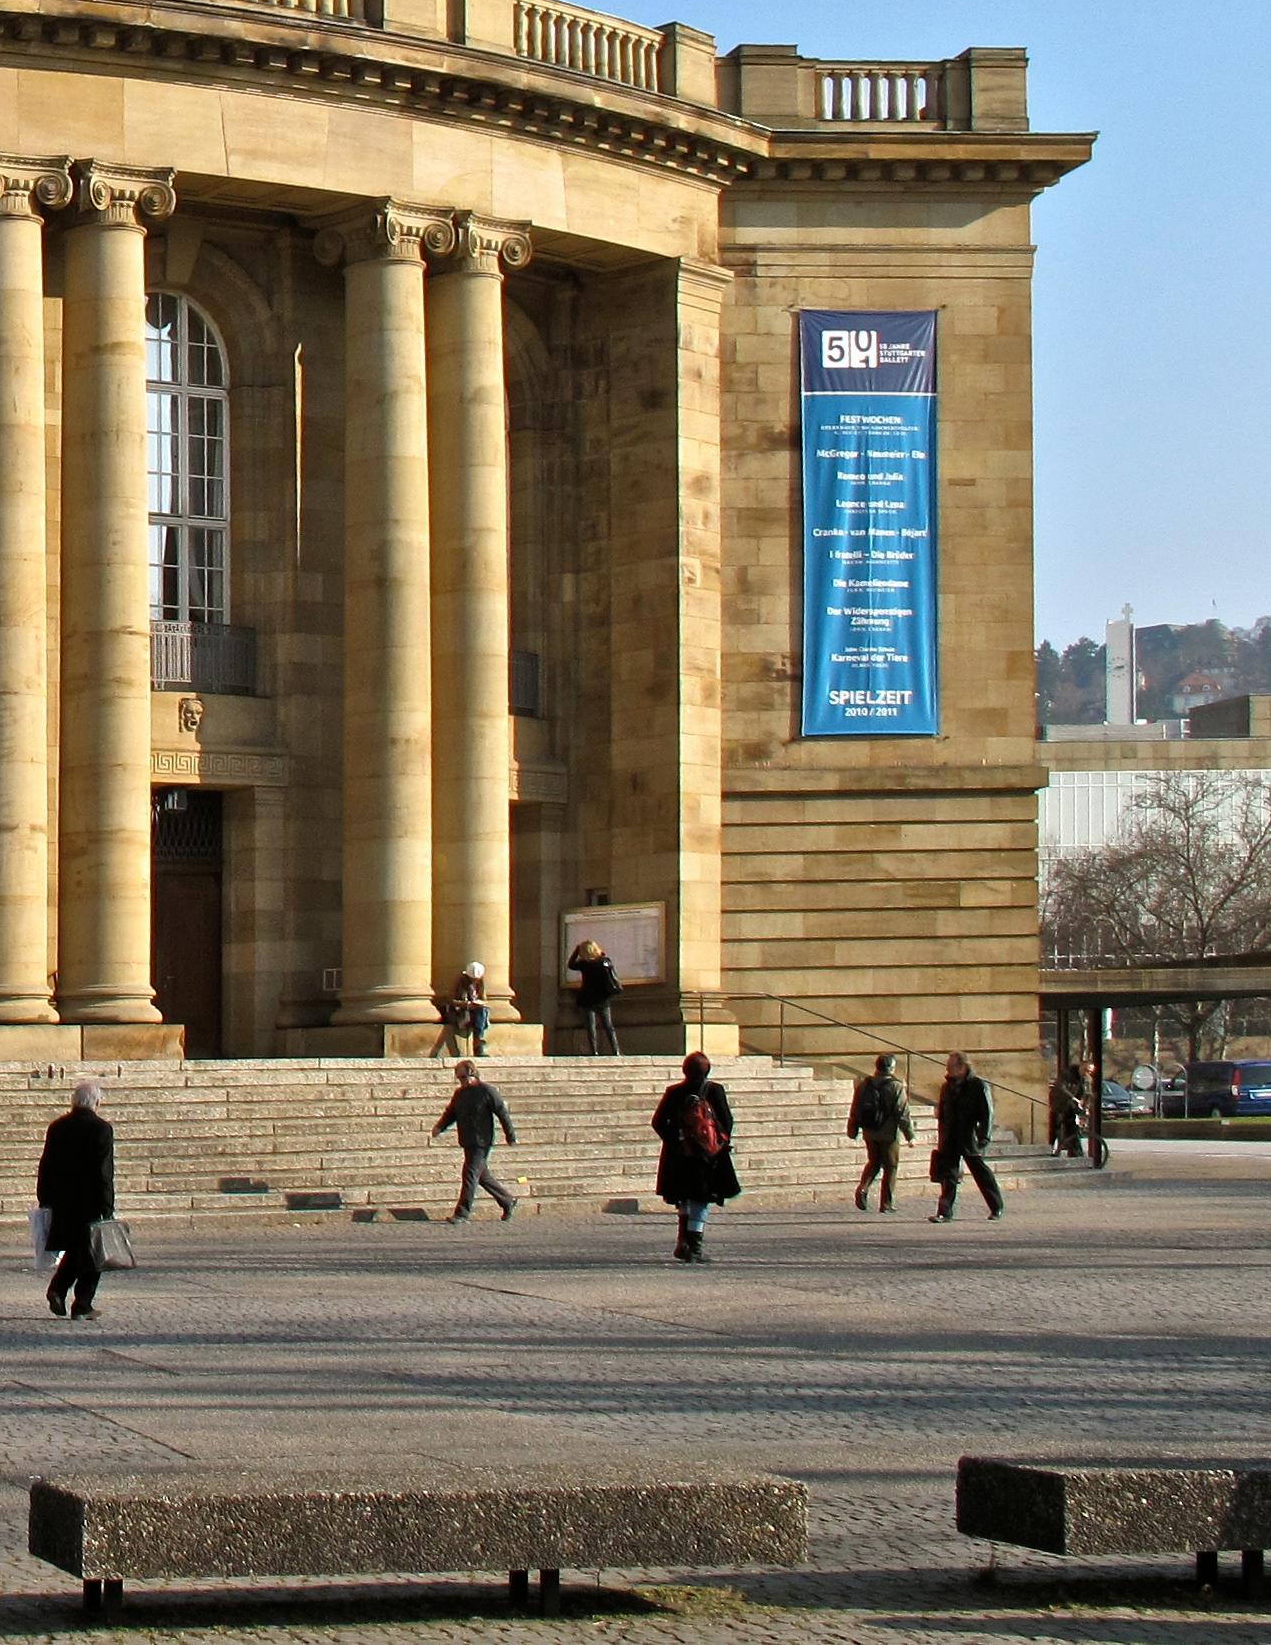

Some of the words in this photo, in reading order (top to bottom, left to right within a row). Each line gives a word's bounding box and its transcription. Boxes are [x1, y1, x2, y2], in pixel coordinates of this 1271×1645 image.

[840, 415, 902, 424] FESTWOCHEN
[868, 472, 883, 481] und
[870, 654, 885, 662] der
[887, 654, 908, 663] Tiere
[829, 690, 913, 705] SPIELZEIT
